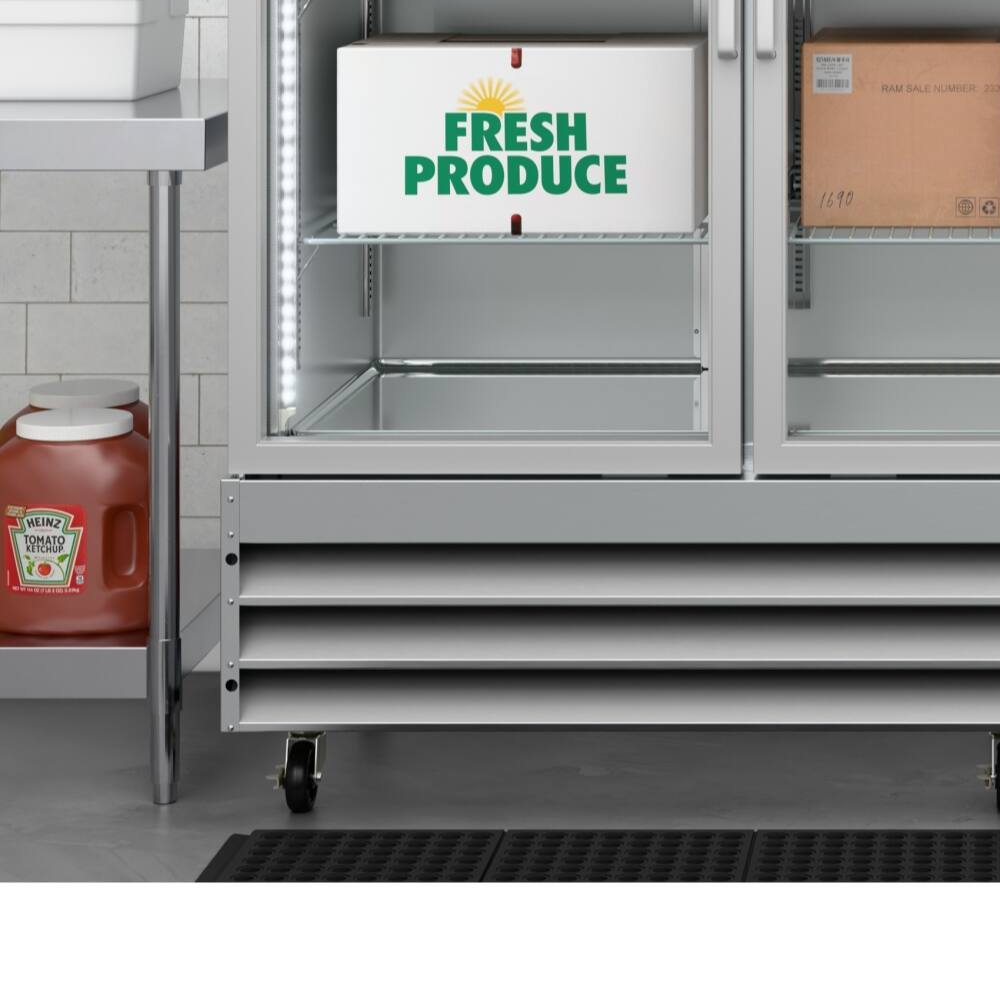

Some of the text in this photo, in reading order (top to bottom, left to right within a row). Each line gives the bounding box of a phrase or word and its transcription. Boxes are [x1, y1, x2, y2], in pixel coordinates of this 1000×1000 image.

[881, 84, 903, 93] RAM
[906, 84, 931, 93] SALE
[934, 84, 976, 93] NUMBER
[445, 112, 587, 151] FRESH
[404, 154, 628, 195] PRODUCE
[819, 190, 854, 209] 1690
[26, 517, 62, 529] HEINZ
[24, 535, 66, 546] TOMATO
[26, 545, 64, 554] KETCHUP
